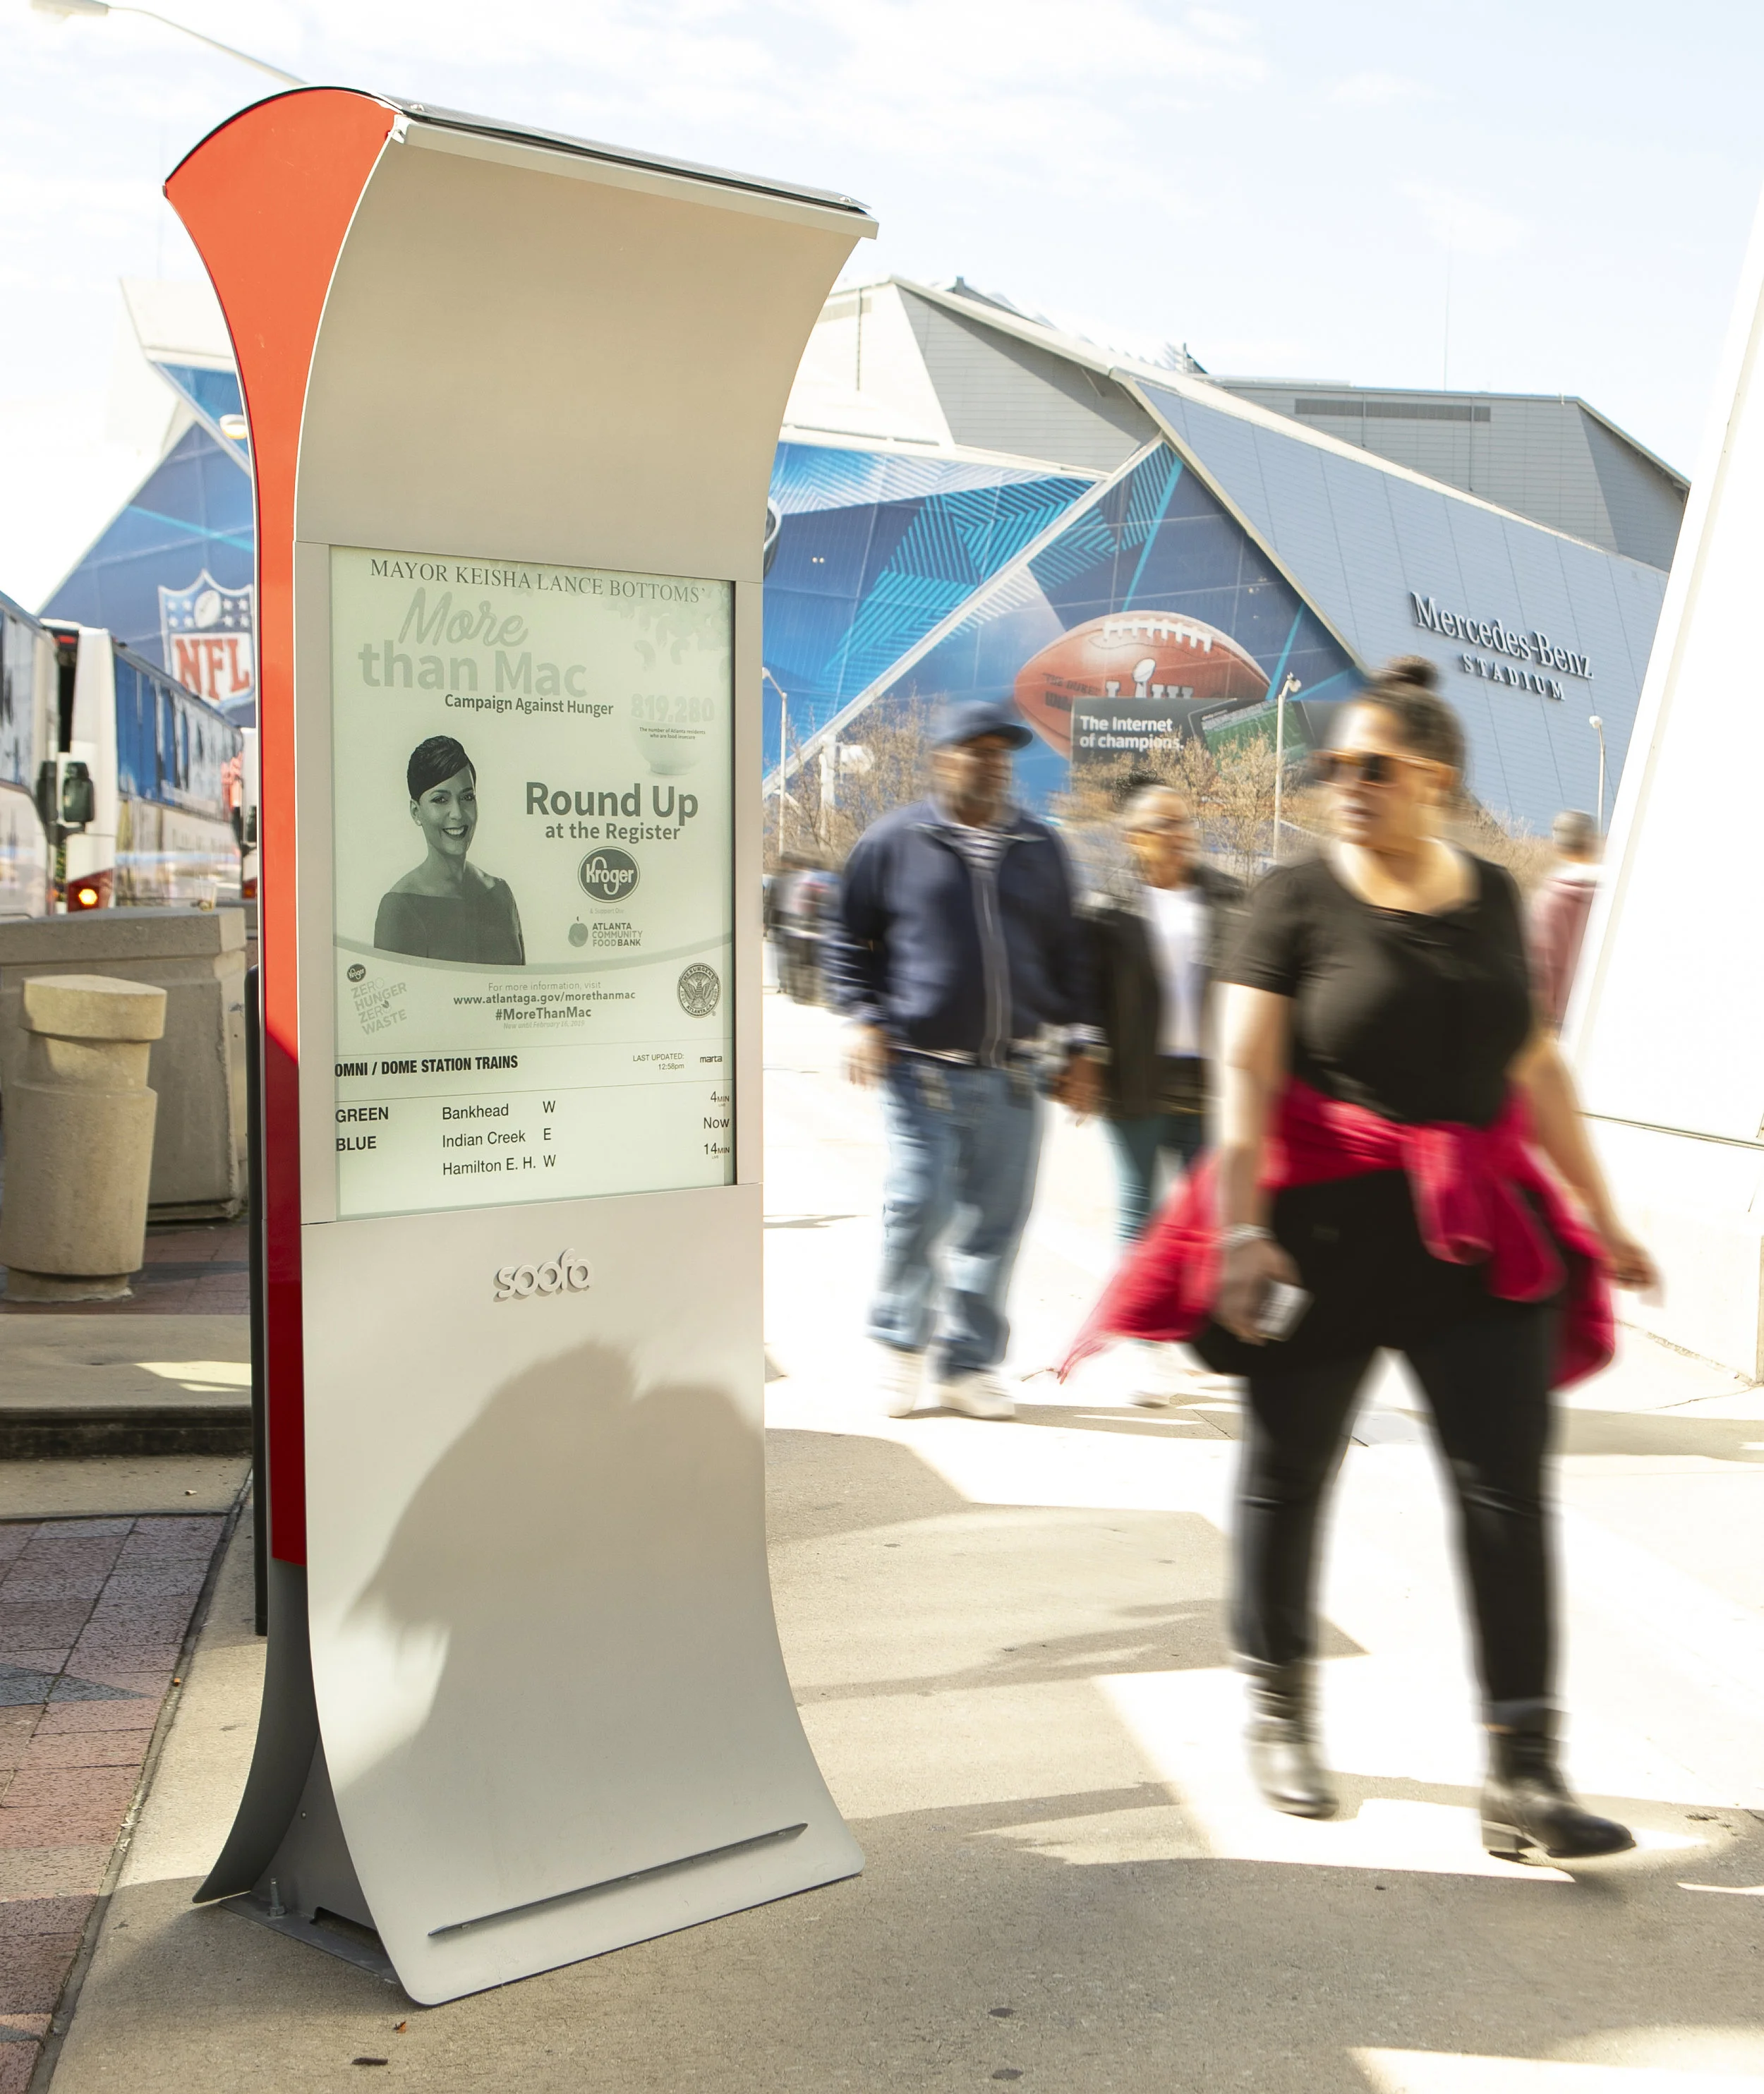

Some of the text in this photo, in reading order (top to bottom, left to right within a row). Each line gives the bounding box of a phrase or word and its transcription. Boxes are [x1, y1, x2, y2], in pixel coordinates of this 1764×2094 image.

[370, 559, 448, 582] MAYOR
[456, 566, 531, 589] KEISHA
[537, 573, 603, 595] LANCE
[398, 586, 529, 647] More
[1410, 591, 1595, 680] Mercedes-Benz
[175, 638, 250, 701] NFL
[357, 639, 588, 698] than Mac
[1461, 652, 1566, 701] STADIUM
[445, 694, 614, 718] Campaign Against Hunger
[1079, 715, 1173, 732] The Internet
[1079, 732, 1185, 752] of champions.
[526, 782, 699, 826] Round Up
[545, 821, 680, 844] at the Register
[586, 857, 634, 895] Kroger
[592, 922, 632, 931] ATLANTA
[592, 930, 643, 939] COMMUNITY
[350, 976, 385, 999] ZERO
[354, 982, 407, 1012] HUNGER
[453, 990, 636, 1005] www.atlantaga.gov/morethanmac
[488, 982, 502, 991] For
[531, 981, 582, 991] information,
[584, 981, 601, 989] visit
[361, 1009, 407, 1035] WASTE
[495, 1006, 592, 1021] #MoreThanMac
[334, 1055, 519, 1077] OMNI / DOME STATION TRAINS
[651, 1053, 684, 1061] UPDATED:
[335, 1106, 389, 1123] GREEN
[442, 1103, 509, 1120] Bankhead
[543, 1100, 555, 1113] W
[336, 1116, 730, 1151] BLUE Indian Creek E Now
[443, 1160, 501, 1175] Hamilton
[506, 1157, 518, 1170] E.
[523, 1156, 536, 1170] H.
[543, 1154, 556, 1168] W
[496, 1248, 593, 1299] soofa
